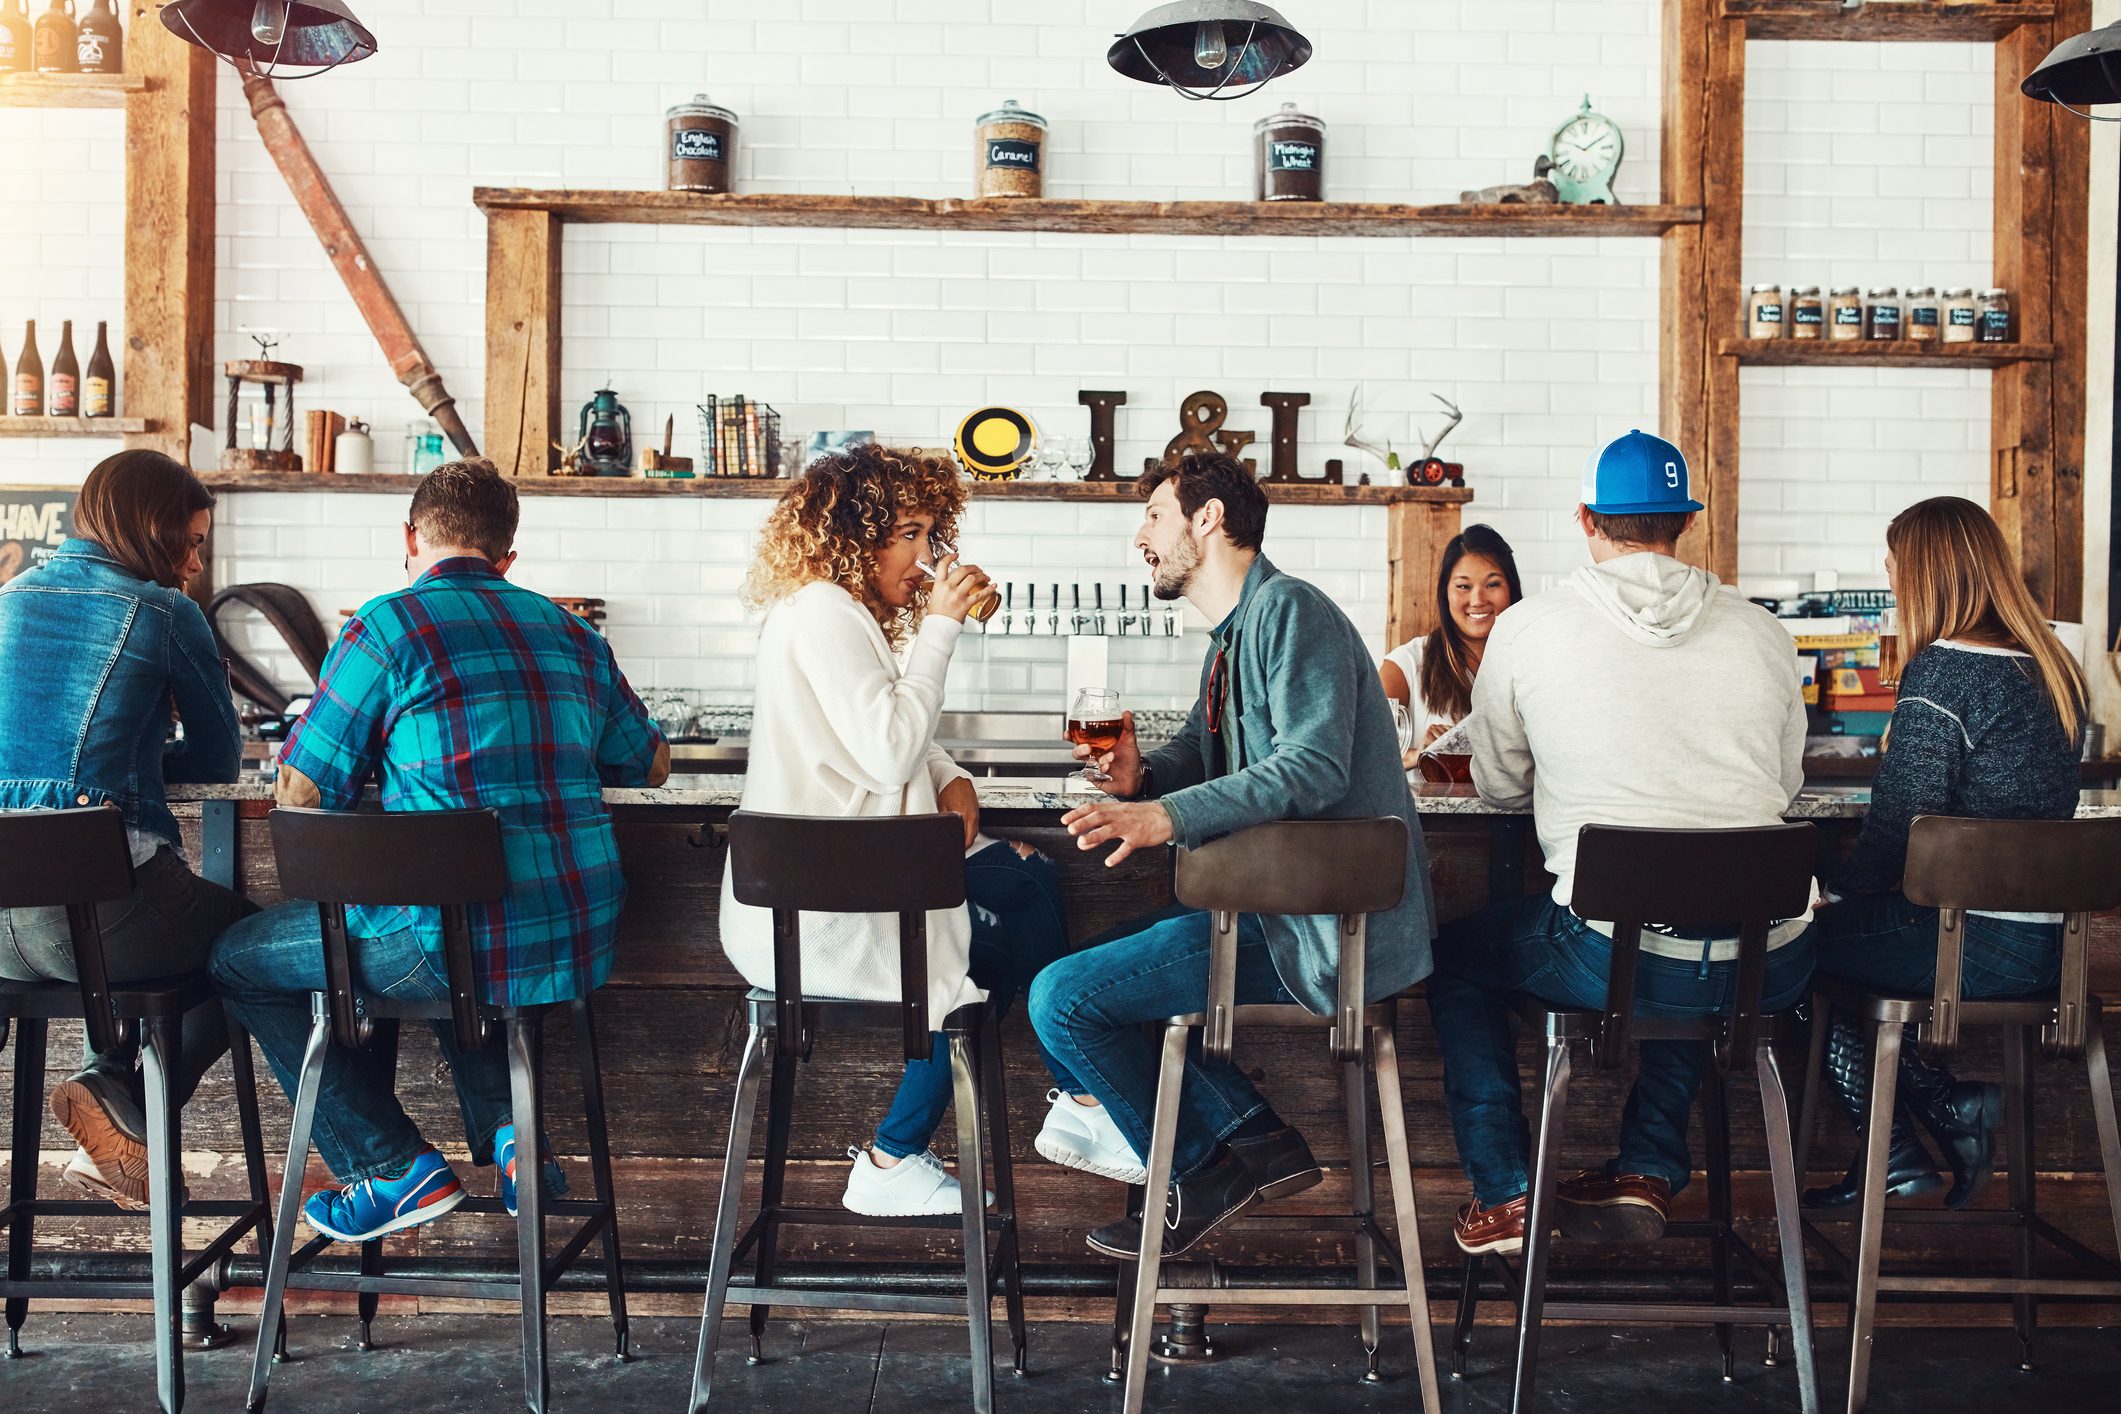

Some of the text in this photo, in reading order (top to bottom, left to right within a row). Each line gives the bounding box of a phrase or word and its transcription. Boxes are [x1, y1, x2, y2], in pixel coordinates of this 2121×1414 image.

[681, 132, 717, 147] English
[991, 145, 1033, 163] Caramel
[1282, 155, 1312, 169] Wheat
[1665, 461, 1679, 488] 9
